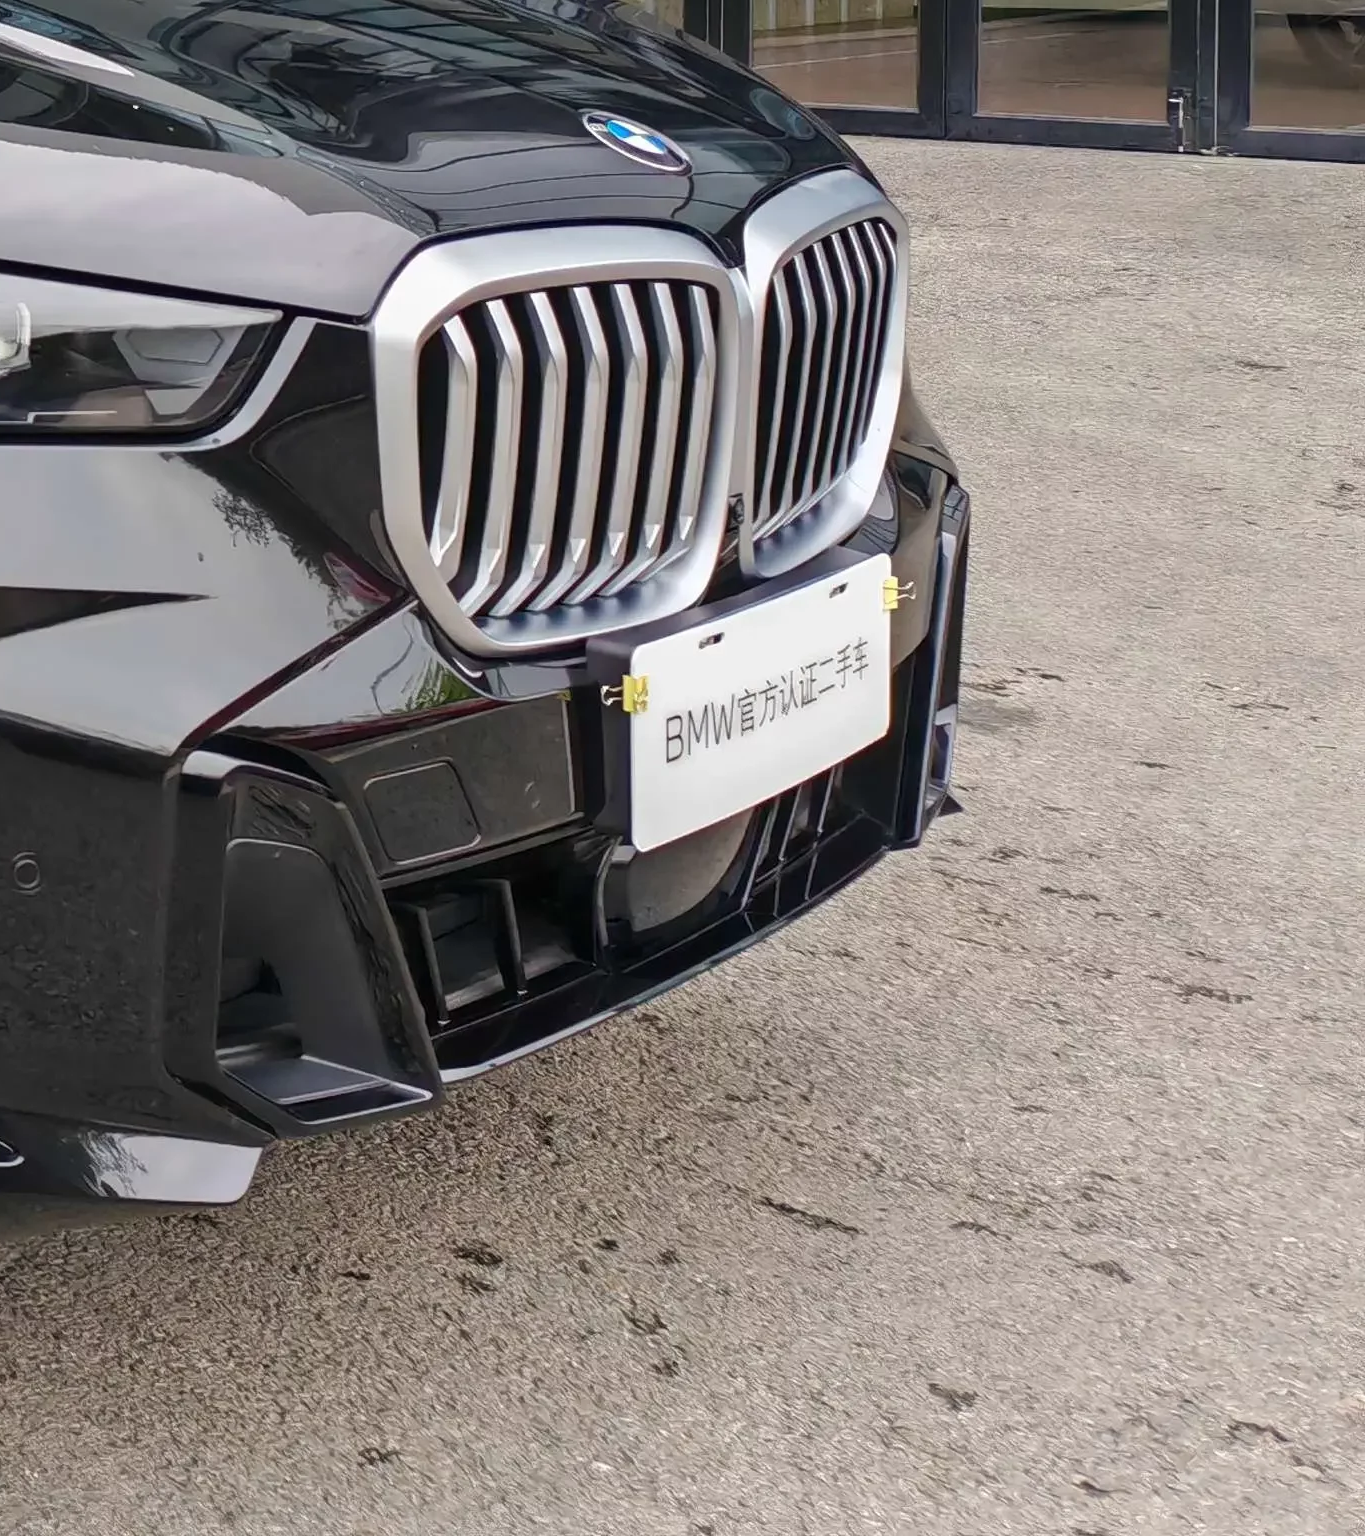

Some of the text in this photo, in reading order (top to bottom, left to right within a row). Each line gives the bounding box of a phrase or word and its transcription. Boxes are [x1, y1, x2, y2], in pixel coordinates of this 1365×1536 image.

[665, 637, 869, 764] BMW官方认证二手车
